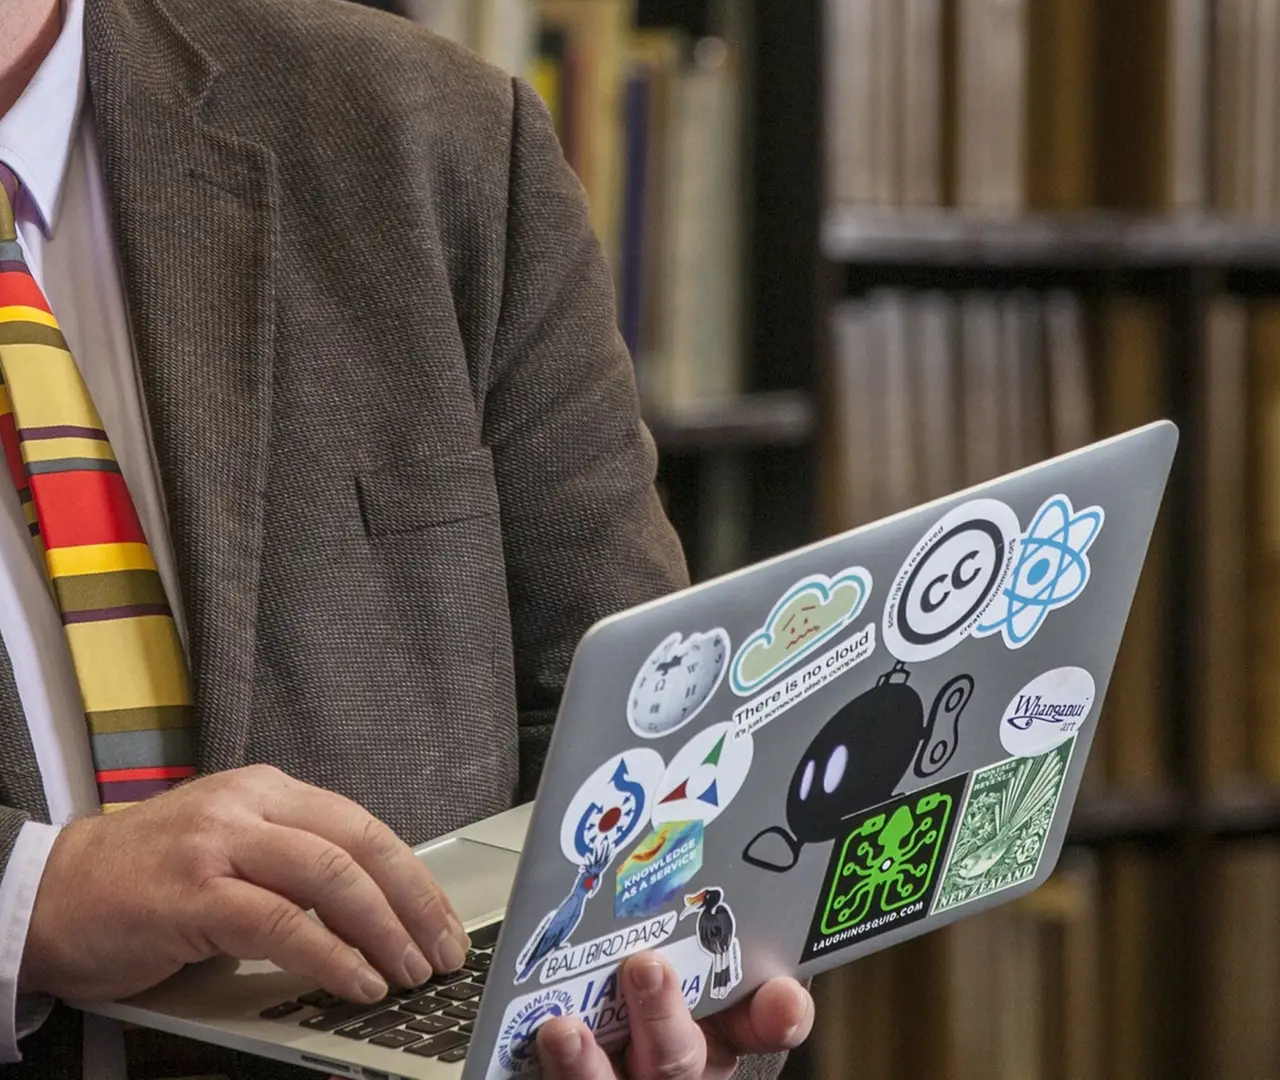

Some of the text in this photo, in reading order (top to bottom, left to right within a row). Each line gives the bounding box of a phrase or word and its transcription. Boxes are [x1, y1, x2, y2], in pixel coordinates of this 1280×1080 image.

[909, 525, 944, 567] reserved
[735, 631, 869, 725] There is no cloud
[747, 716, 763, 732] just
[764, 691, 802, 719] someone
[804, 675, 827, 693] else's
[829, 648, 869, 678] computer
[1010, 694, 1089, 723] Whanganui
[622, 849, 697, 902] AS A SERVICE
[624, 838, 696, 888] KNOWLEDGE
[940, 864, 1034, 908] NEW ZEALAND
[546, 948, 586, 979] BALI
[586, 933, 624, 964] BIRD
[624, 915, 676, 951] PARK
[812, 901, 924, 952] LAUGHINGSQUID.COM
